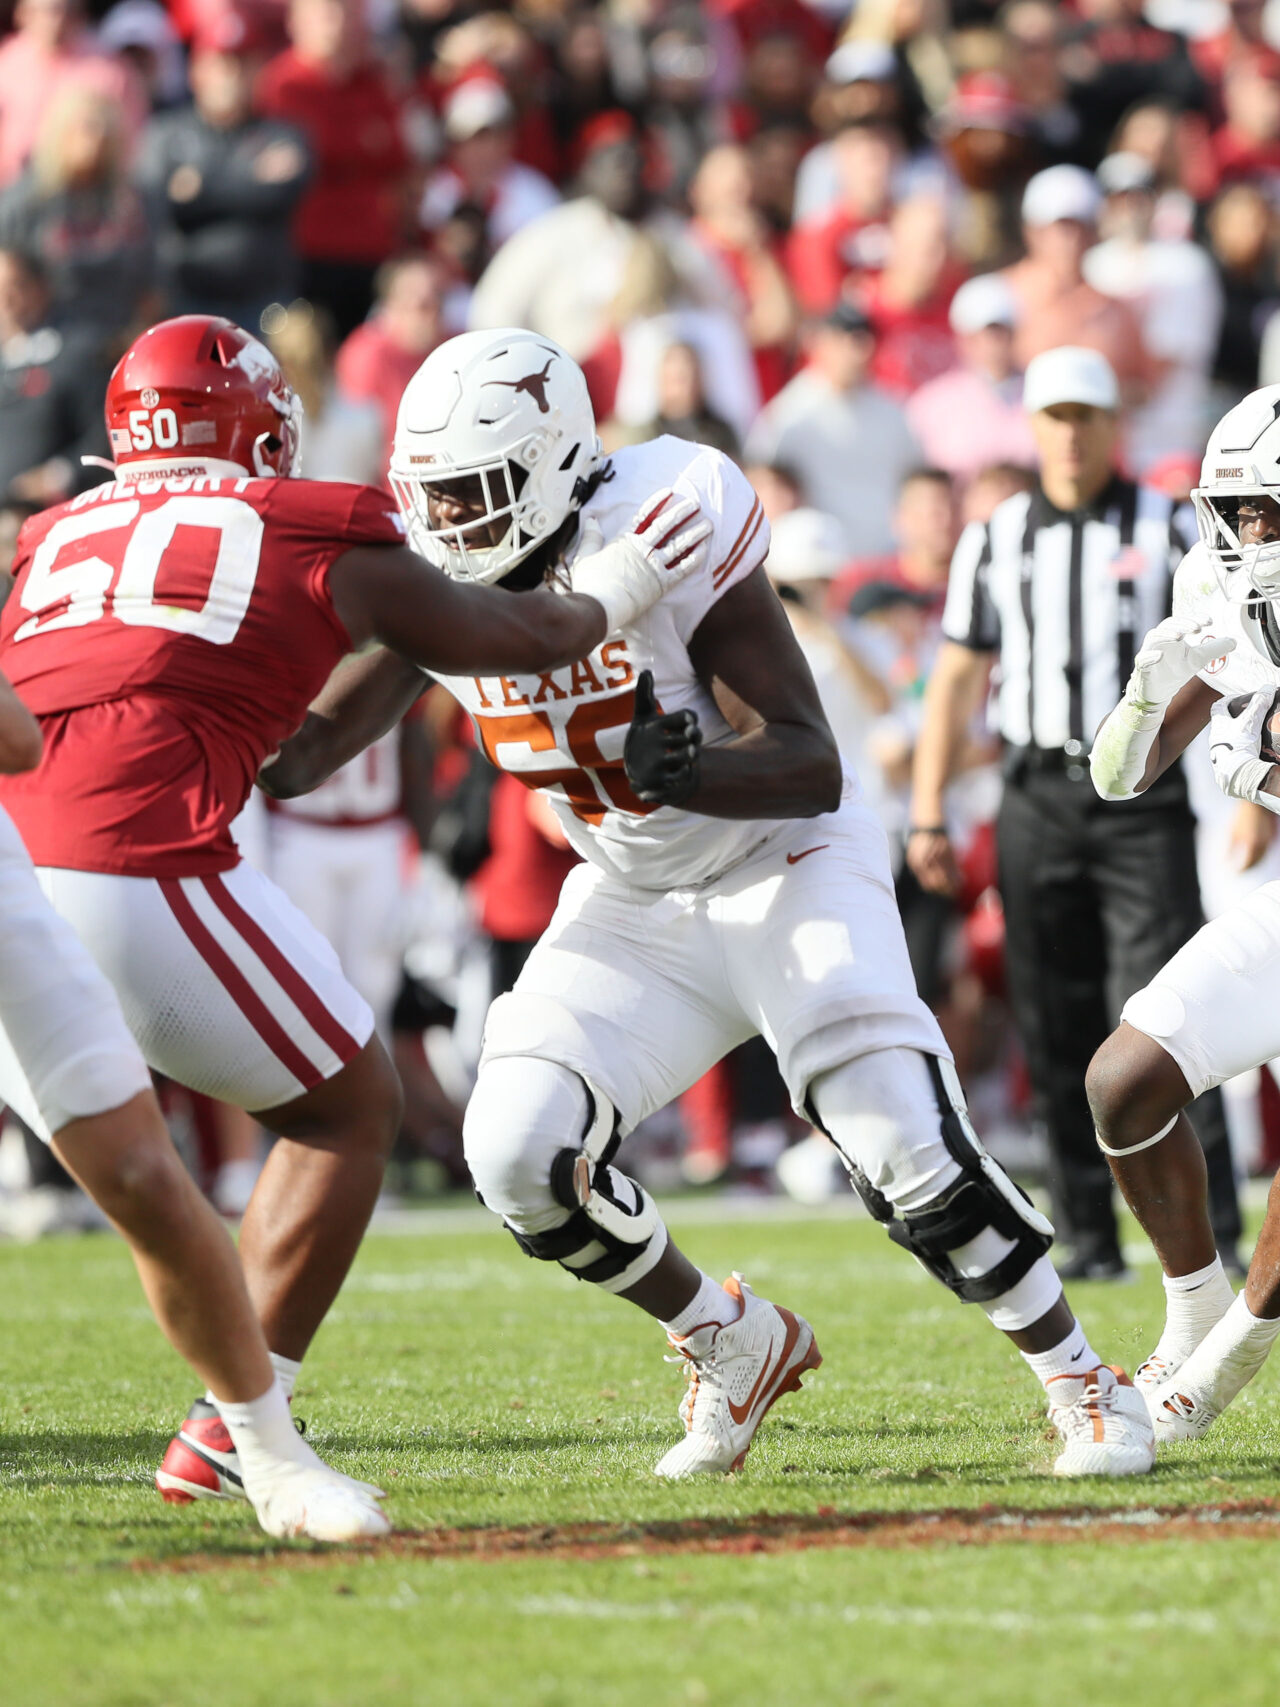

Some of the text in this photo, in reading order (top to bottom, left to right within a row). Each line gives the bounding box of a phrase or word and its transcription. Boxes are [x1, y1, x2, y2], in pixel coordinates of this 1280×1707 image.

[129, 408, 179, 451] 50
[1215, 467, 1244, 478] HORNS
[14, 496, 265, 645] 50
[474, 640, 635, 709] TEXAS
